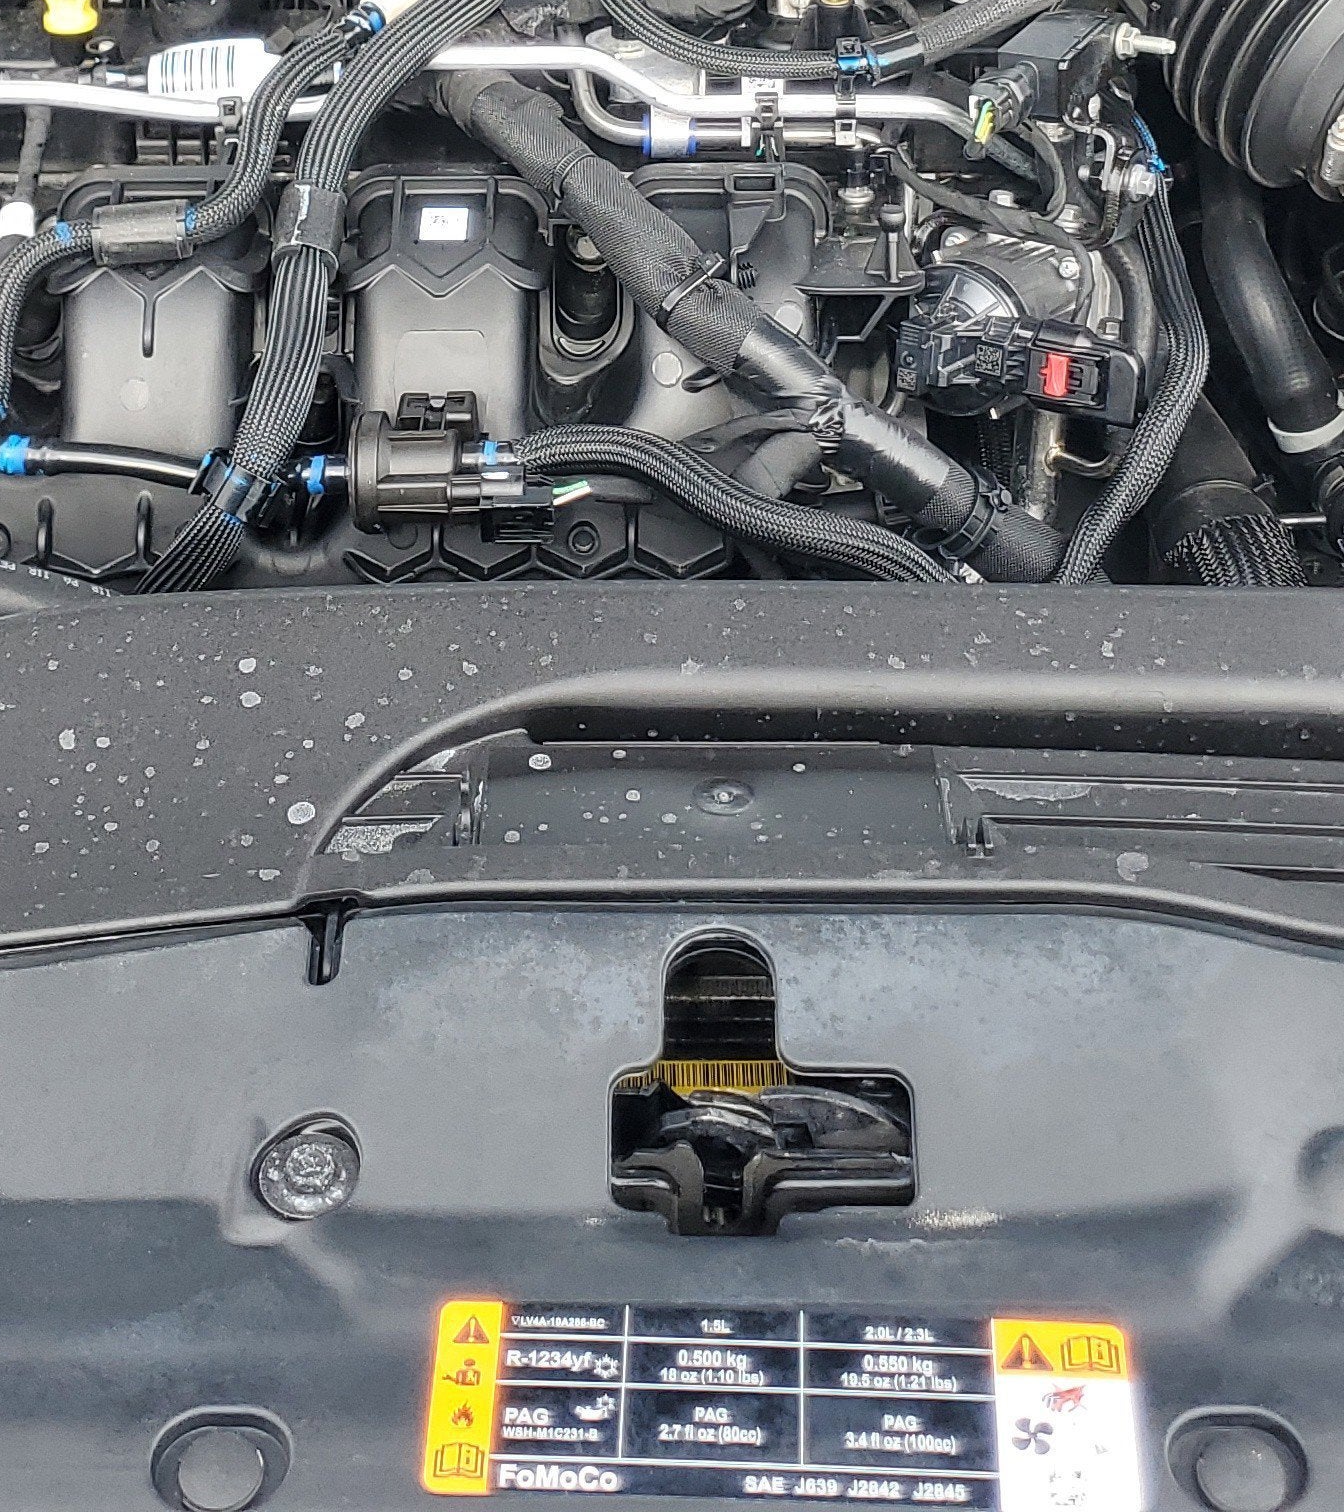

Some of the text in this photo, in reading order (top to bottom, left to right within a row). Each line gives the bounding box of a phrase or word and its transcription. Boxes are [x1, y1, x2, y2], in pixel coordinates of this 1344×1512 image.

[701, 1319, 731, 1333] 1.5L
[864, 1325, 895, 1341] 2.0L
[904, 1327, 935, 1343] 2.3L
[506, 1349, 593, 1372] R-1234yf
[678, 1349, 747, 1370] 0.500 kg
[911, 1356, 933, 1377] kg
[680, 1370, 698, 1383] oz
[700, 1368, 735, 1385] (1.10
[738, 1369, 764, 1387] lbs)
[873, 1376, 892, 1389] oz
[894, 1373, 927, 1391] (1.21
[930, 1375, 958, 1393] lbs)
[504, 1407, 550, 1425] PAG
[694, 1406, 729, 1423] PAG
[882, 1414, 919, 1430] PAG
[659, 1423, 762, 1446] 2.7 fl oz (80cc)
[844, 1431, 957, 1455] 3.4 fl oz (100cc)
[499, 1463, 621, 1491] FoMoCo
[744, 1475, 786, 1493] SAE
[794, 1477, 839, 1495] J639
